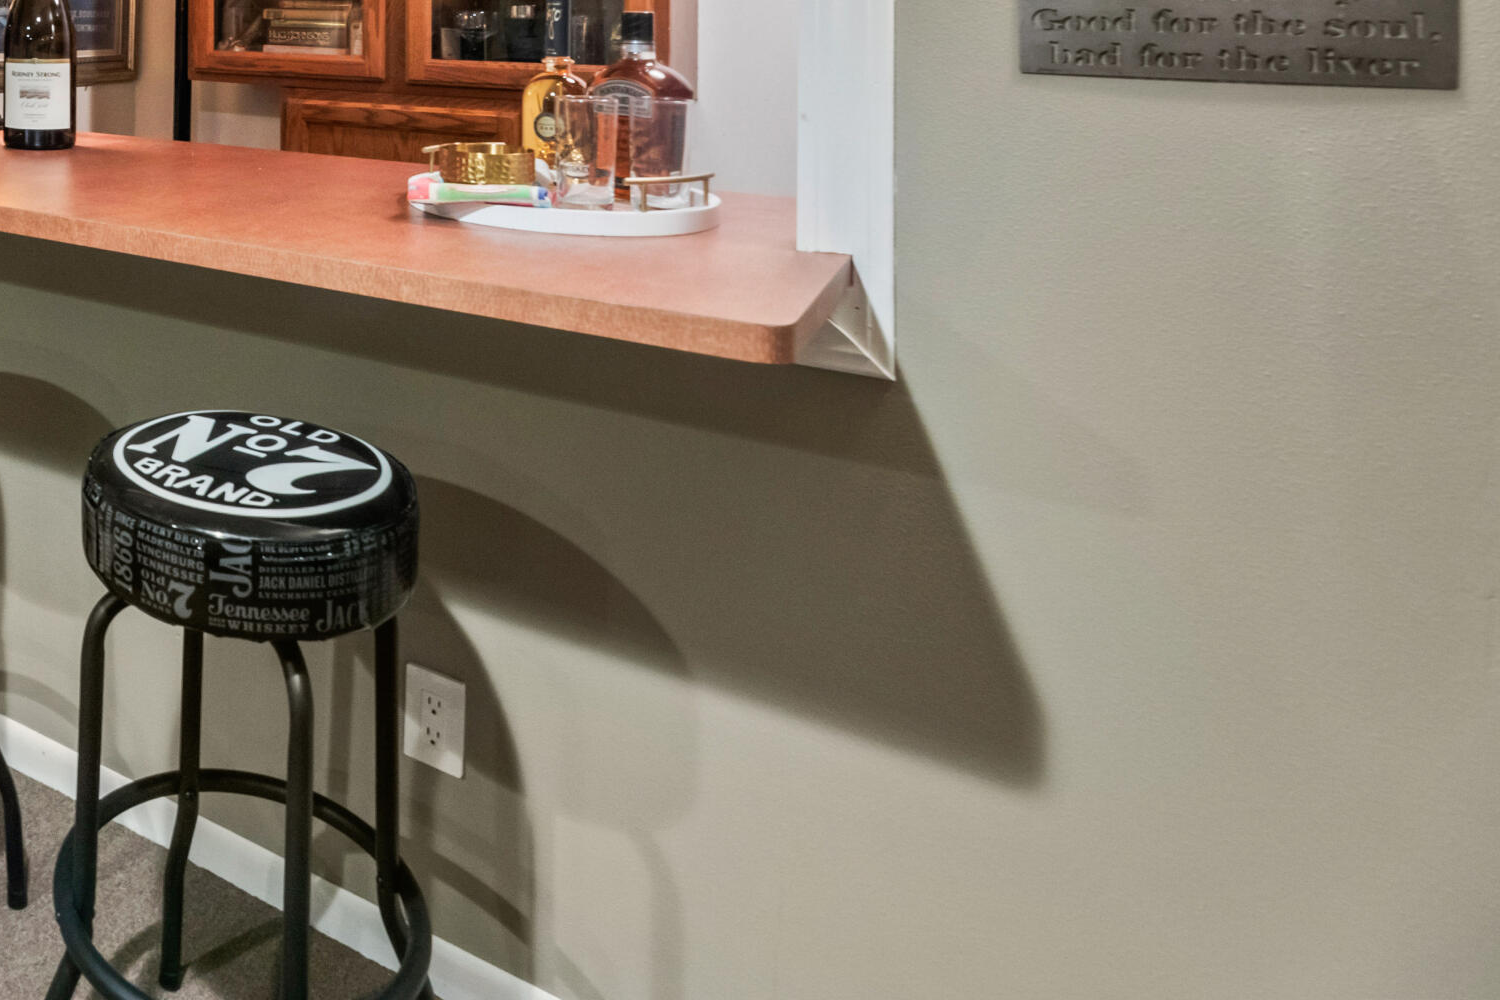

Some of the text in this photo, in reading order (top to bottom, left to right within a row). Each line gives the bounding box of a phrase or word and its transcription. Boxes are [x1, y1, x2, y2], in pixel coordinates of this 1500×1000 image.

[1031, 7, 1444, 42] Good for the soul.
[1049, 41, 1422, 77] bad for the liver
[250, 415, 341, 443] OLD
[133, 457, 274, 507] BRAND
[245, 446, 378, 495] 7
[137, 530, 163, 546] MADE
[164, 541, 193, 556] ONLY
[139, 519, 174, 538] EVERY
[113, 526, 133, 593] 1866
[136, 541, 205, 571] LYNCHBURG
[137, 553, 204, 584] TENNESSEE
[141, 567, 166, 586] Old
[258, 575, 286, 589] JACK
[288, 574, 326, 590] DANIEL
[141, 580, 196, 619] No. 7
[208, 593, 311, 622] Tennessee
[228, 619, 309, 634] WHISKEY
[315, 600, 369, 632] JACK
